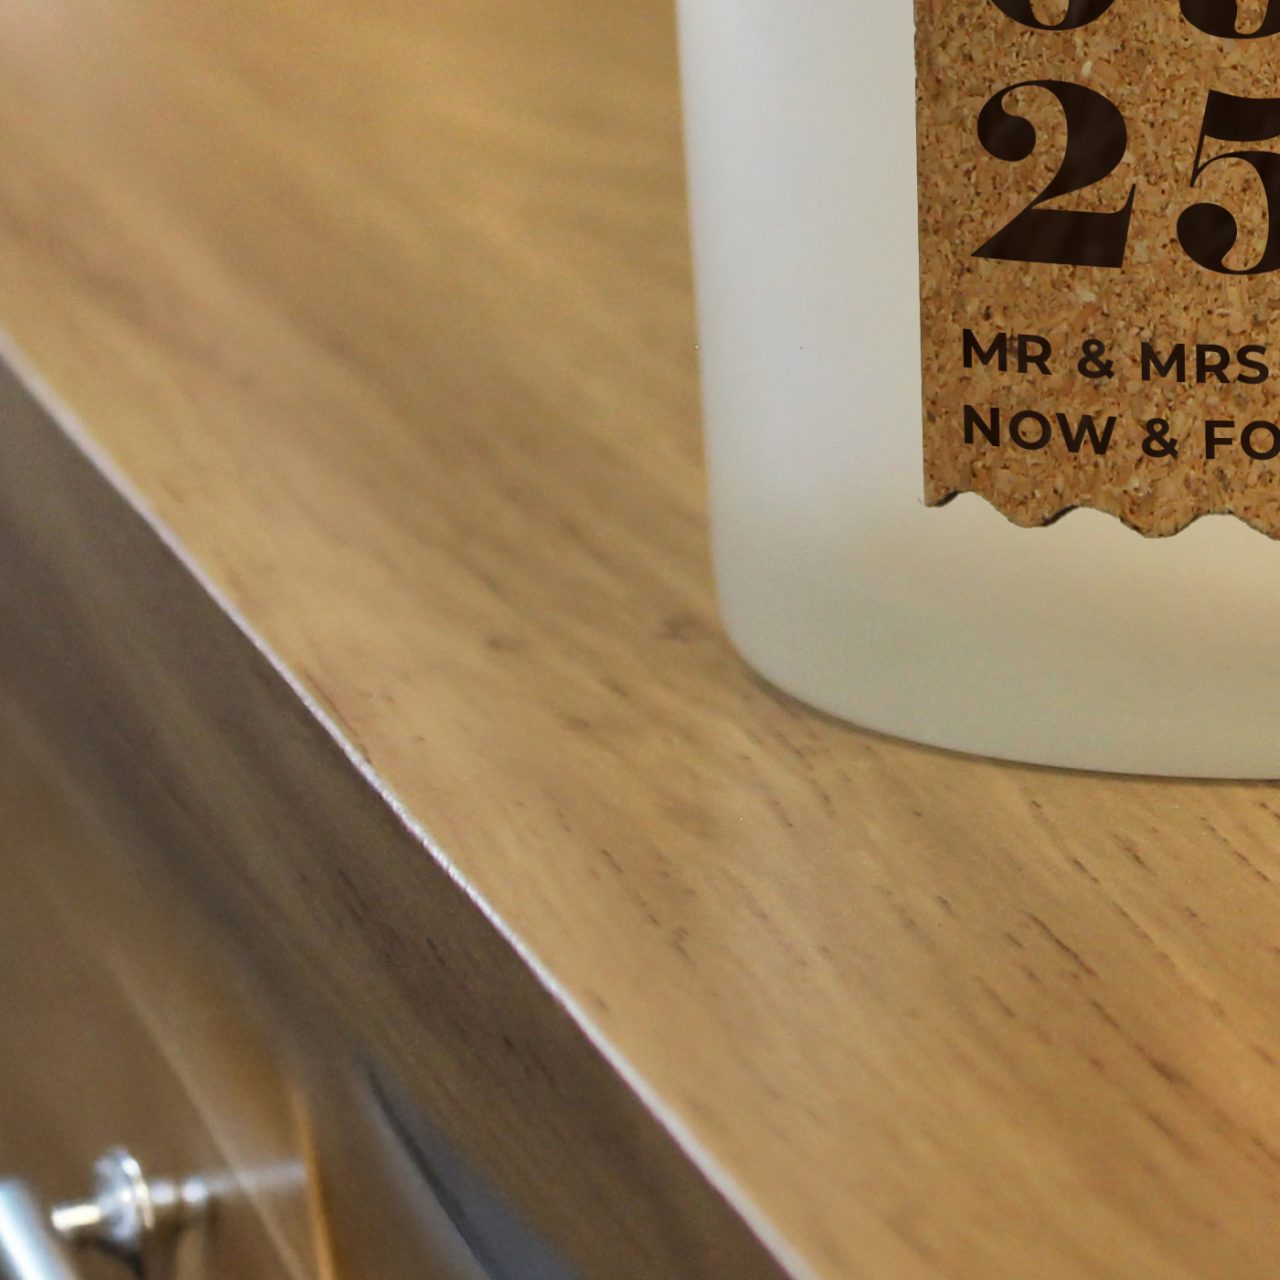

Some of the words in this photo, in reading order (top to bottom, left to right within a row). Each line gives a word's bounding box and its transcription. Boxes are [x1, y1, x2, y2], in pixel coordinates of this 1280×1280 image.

[961, 328, 1053, 376] MR
[1077, 334, 1115, 380] &
[1140, 337, 1269, 385] MRS
[962, 404, 1118, 457] NOW
[1140, 417, 1180, 462] &
